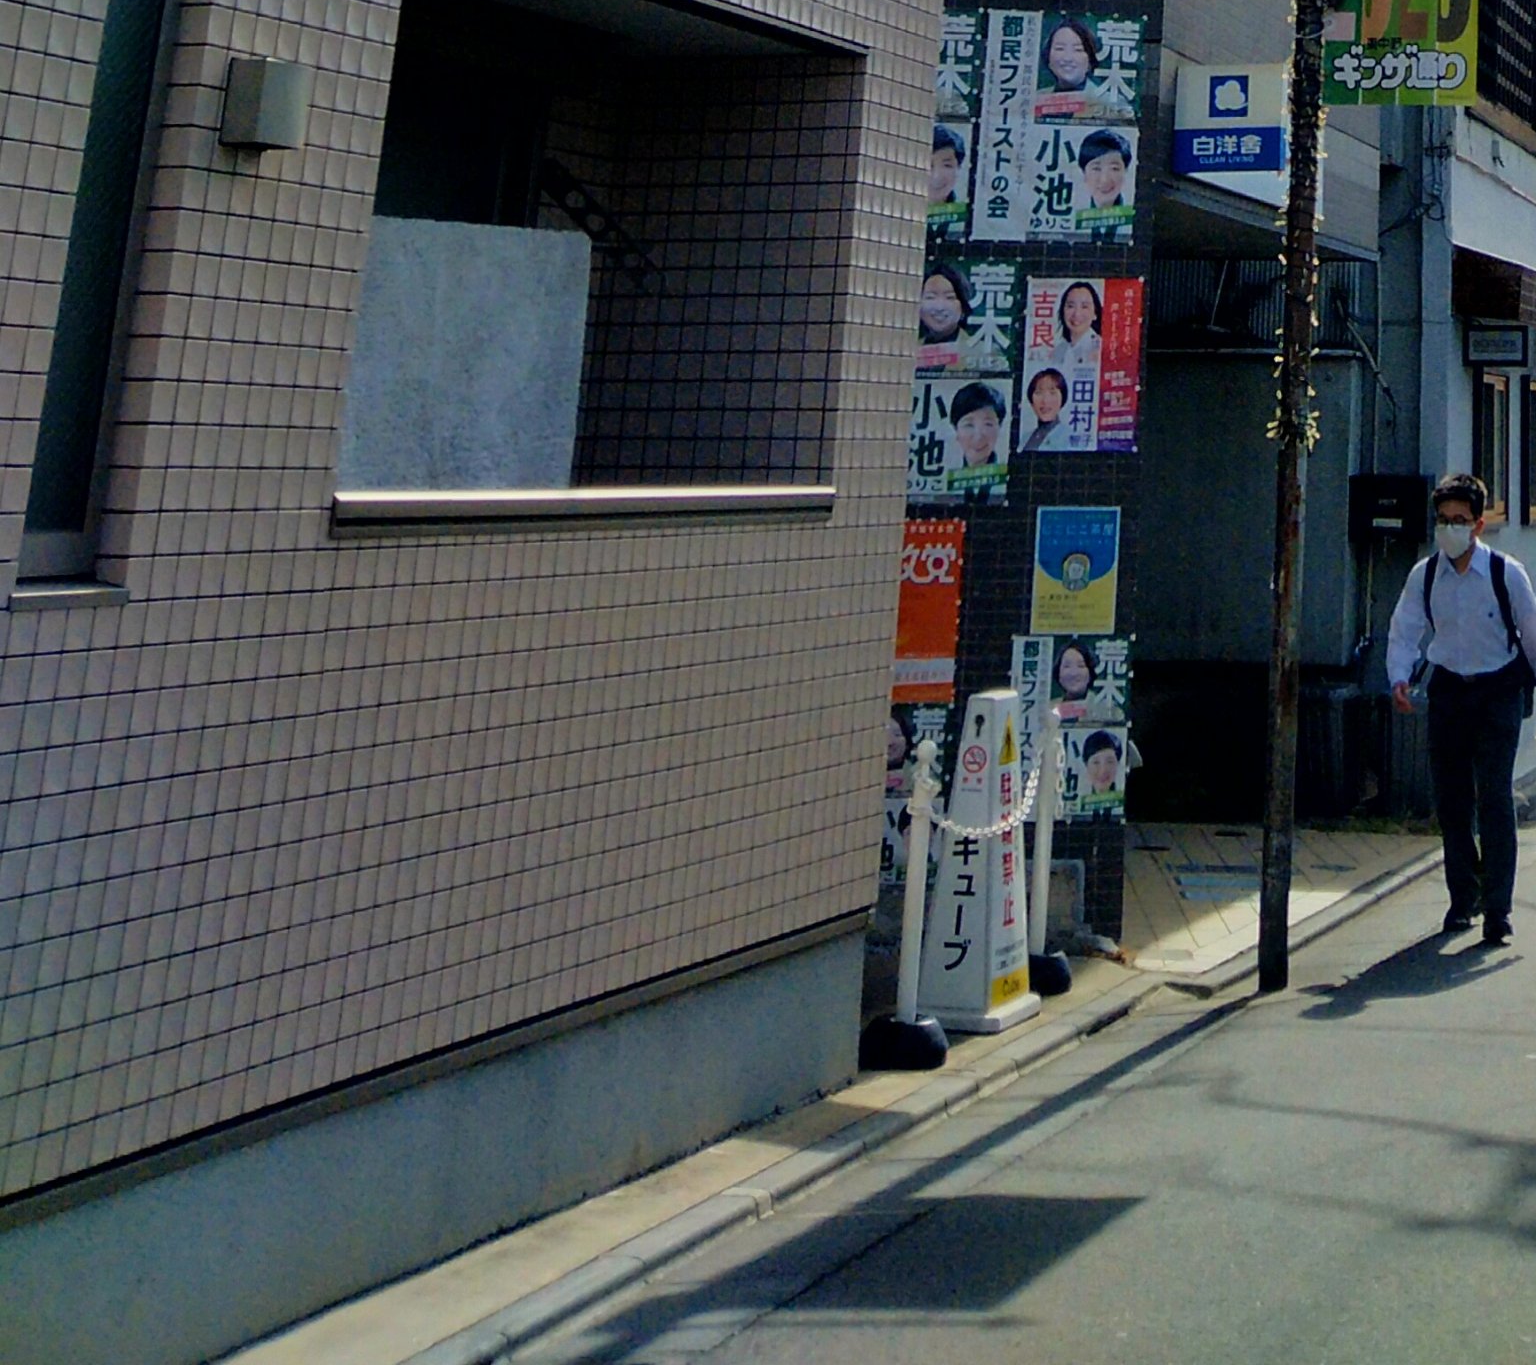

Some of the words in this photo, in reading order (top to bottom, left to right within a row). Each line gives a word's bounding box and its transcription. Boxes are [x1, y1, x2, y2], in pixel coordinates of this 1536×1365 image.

[1094, 20, 1139, 103] 荒木
[1332, 44, 1468, 90] ギンザ通り
[987, 16, 1025, 220] 都民ファーストの会
[1033, 129, 1077, 217] 小池
[1199, 156, 1226, 164] CLEAN
[1228, 155, 1255, 163] LIVING
[1030, 216, 1073, 230] ゆりこ
[966, 263, 1015, 354] 荒木
[1029, 290, 1059, 349] 吉良
[1068, 379, 1095, 433] 田村
[1068, 434, 1094, 448] 智子
[1093, 640, 1128, 707] 荒木
[1018, 640, 1040, 797] 都民ファーストの
[942, 835, 980, 972] キューブ
